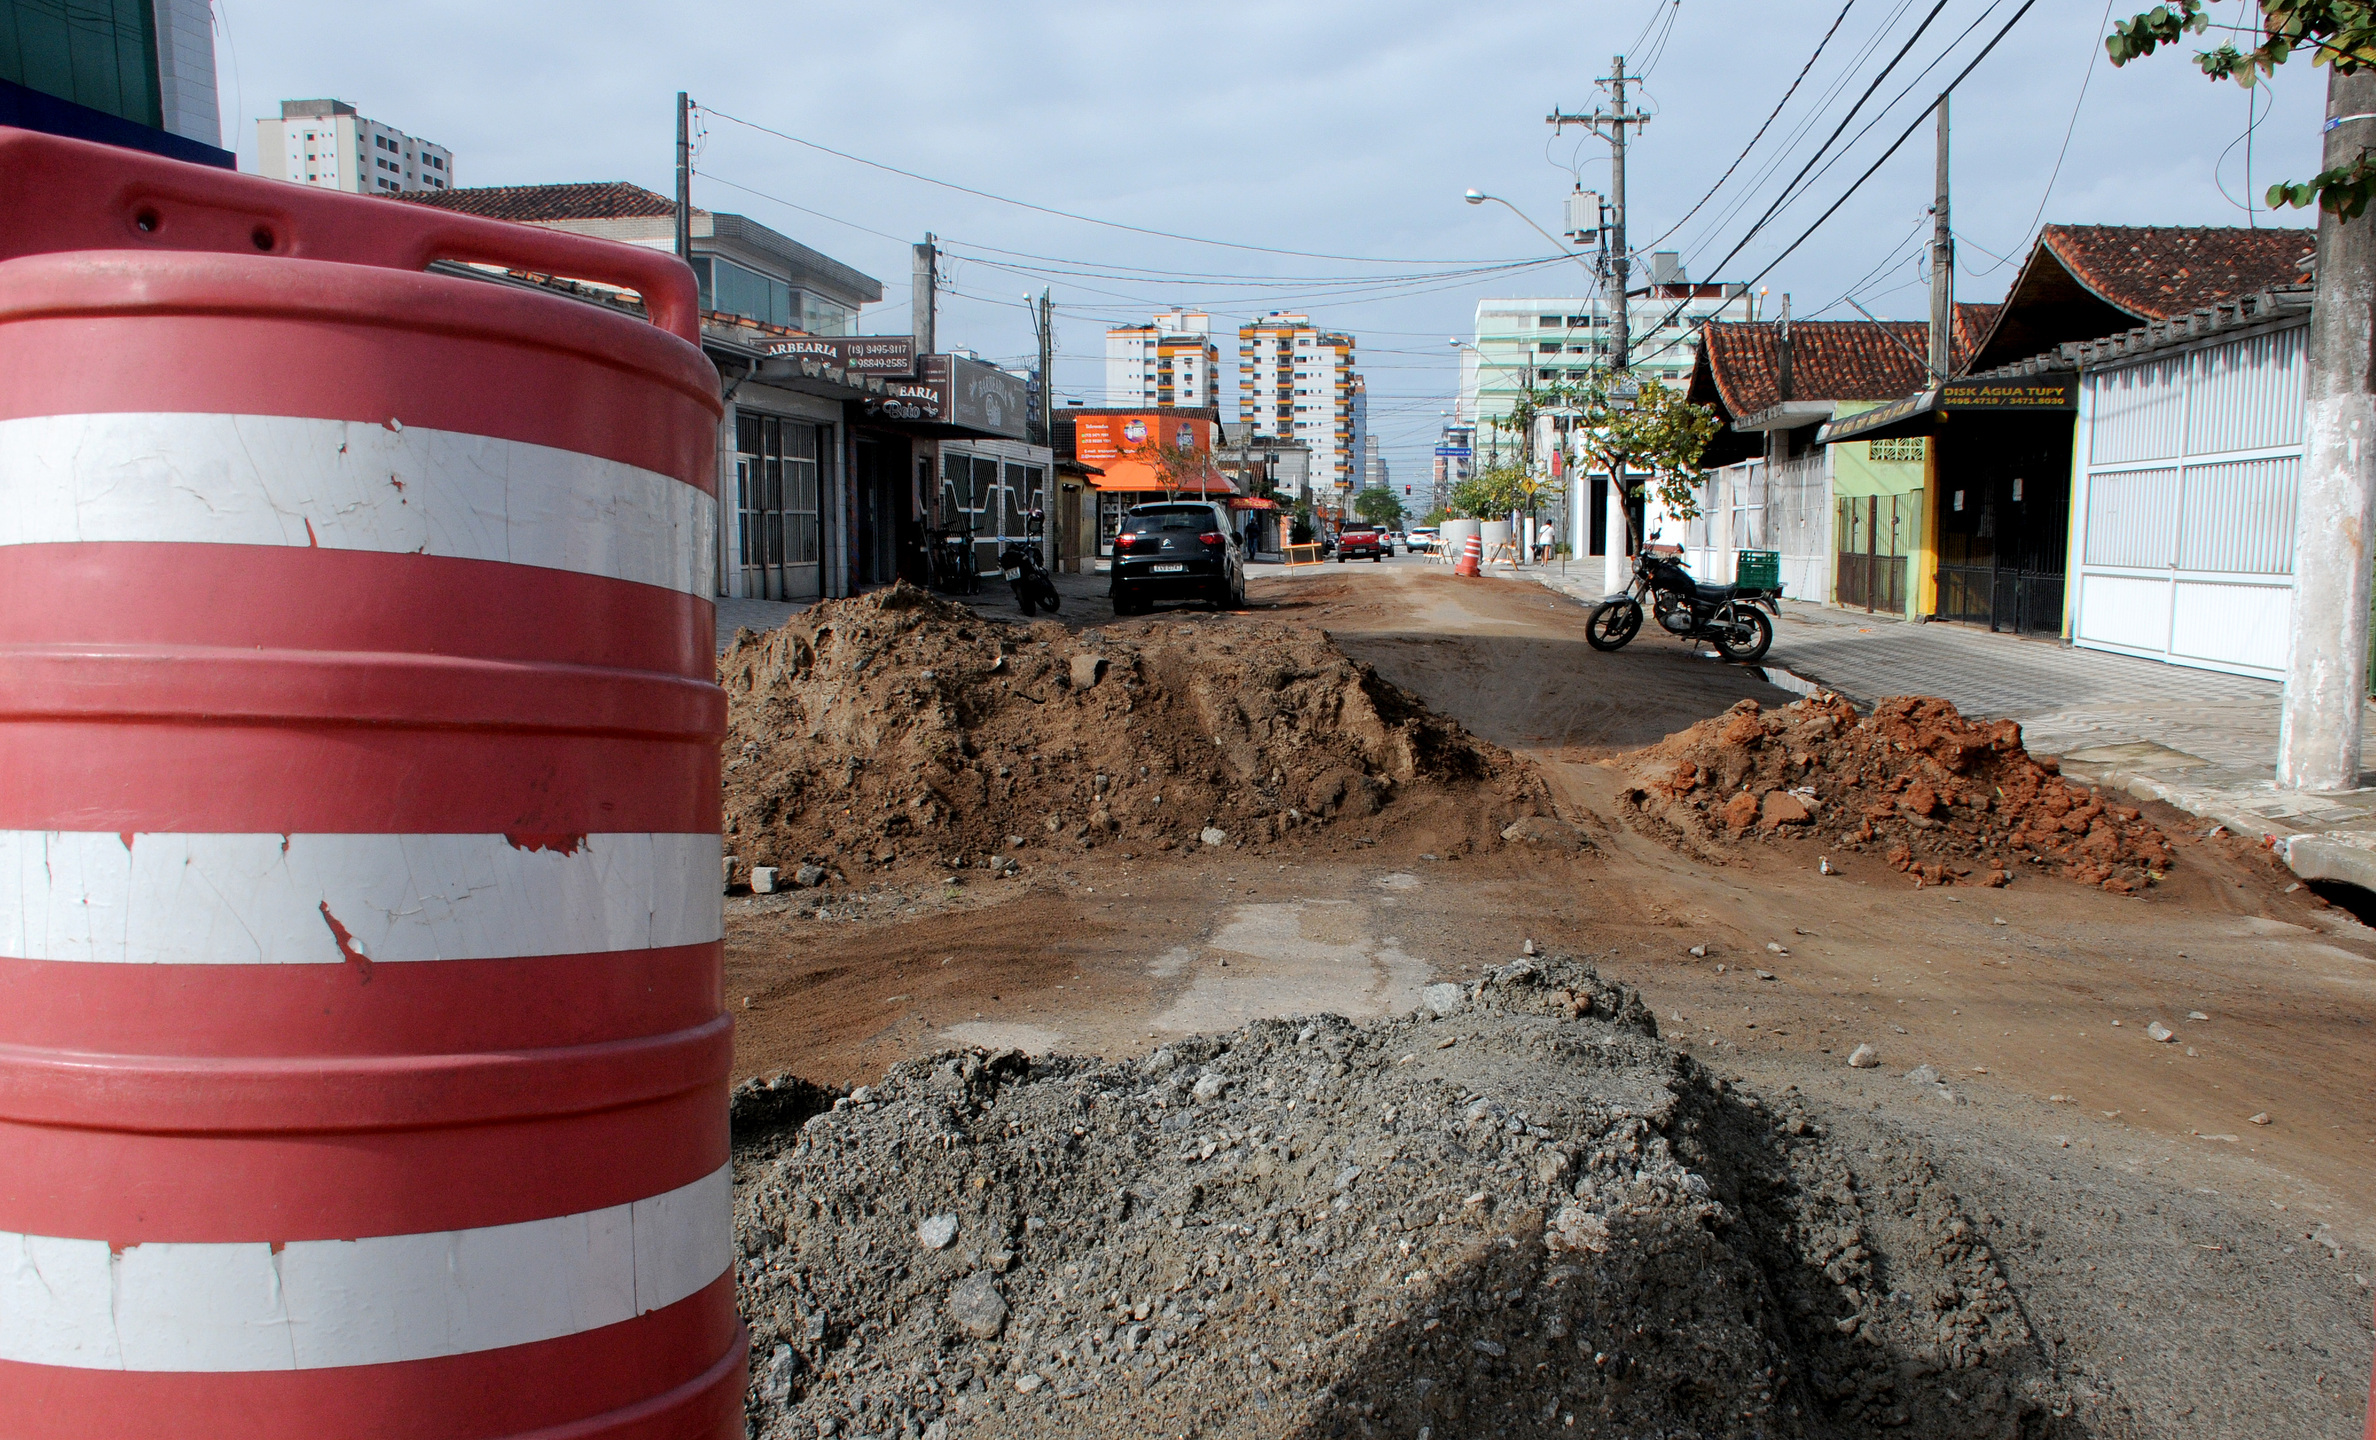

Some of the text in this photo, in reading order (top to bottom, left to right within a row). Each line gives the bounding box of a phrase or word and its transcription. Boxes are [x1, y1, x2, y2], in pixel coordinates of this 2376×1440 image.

[768, 342, 837, 358] ARBEARIA
[857, 358, 908, 368] 98849-2585
[1944, 386, 2065, 396] DISK ÁGUA TUPY
